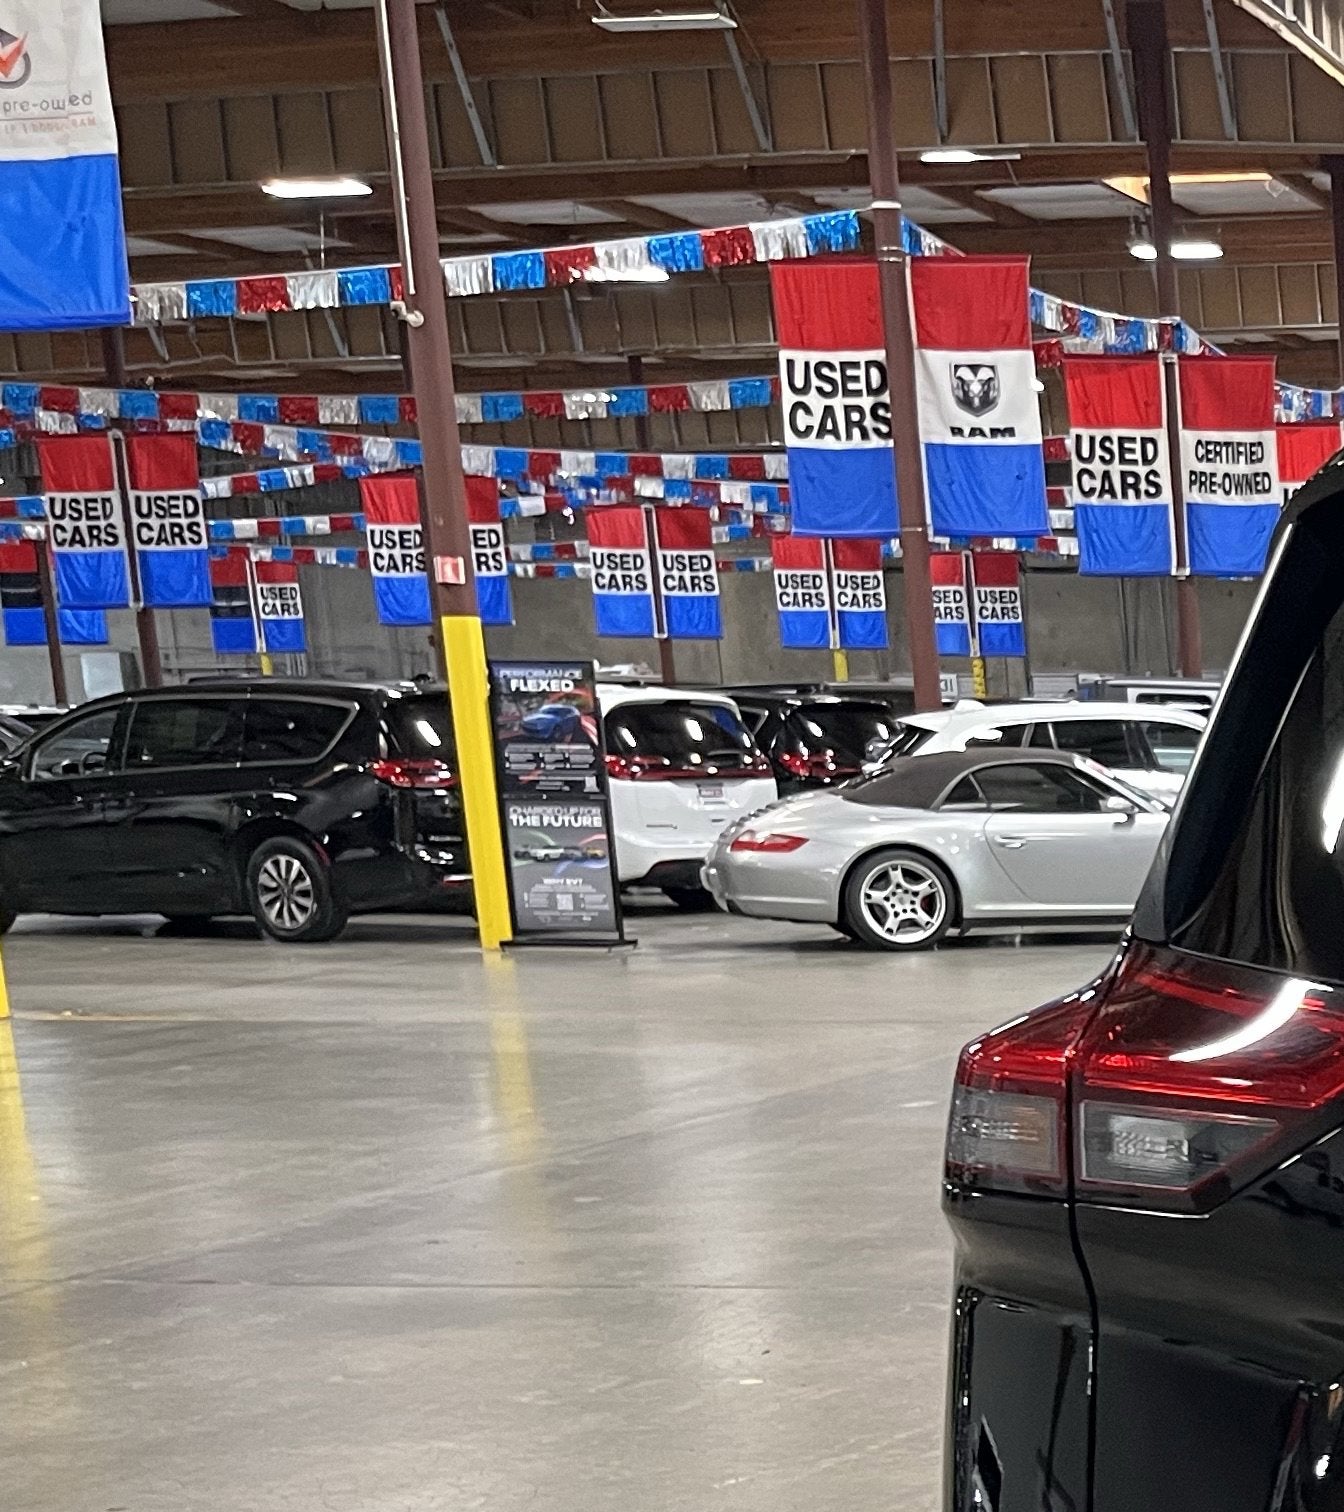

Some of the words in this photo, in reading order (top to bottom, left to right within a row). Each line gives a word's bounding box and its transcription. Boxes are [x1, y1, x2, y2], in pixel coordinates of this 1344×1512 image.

[786, 359, 888, 399] USED
[789, 401, 892, 441] CARS
[950, 426, 1016, 438] RAM
[1075, 434, 1159, 466] USED
[1195, 439, 1264, 465] CERTIFIED
[1076, 468, 1163, 500] CARS
[1189, 470, 1272, 496] PRE-OWNED
[49, 496, 114, 521] USED
[134, 495, 200, 519] USED
[53, 523, 119, 548] CARS
[136, 521, 203, 546] CARS
[369, 528, 423, 549] USED
[472, 528, 500, 549] ED
[373, 552, 426, 573] CARS
[475, 551, 503, 572] RS
[592, 552, 644, 571] USED
[662, 554, 712, 572] USED
[594, 573, 648, 592] CARS
[663, 575, 716, 593] CARS
[777, 573, 823, 590] USED
[837, 573, 881, 591] USED
[261, 586, 298, 600] USED
[779, 591, 826, 608] CARS
[838, 591, 883, 608] CARS
[932, 589, 963, 604] SED
[977, 589, 1018, 604] USED
[262, 602, 300, 616] CARS
[935, 606, 965, 620] ARS
[979, 606, 1020, 620] CARS
[510, 679, 574, 693] FLEXED
[510, 814, 540, 827] THE
[542, 814, 602, 828] FUTURE
